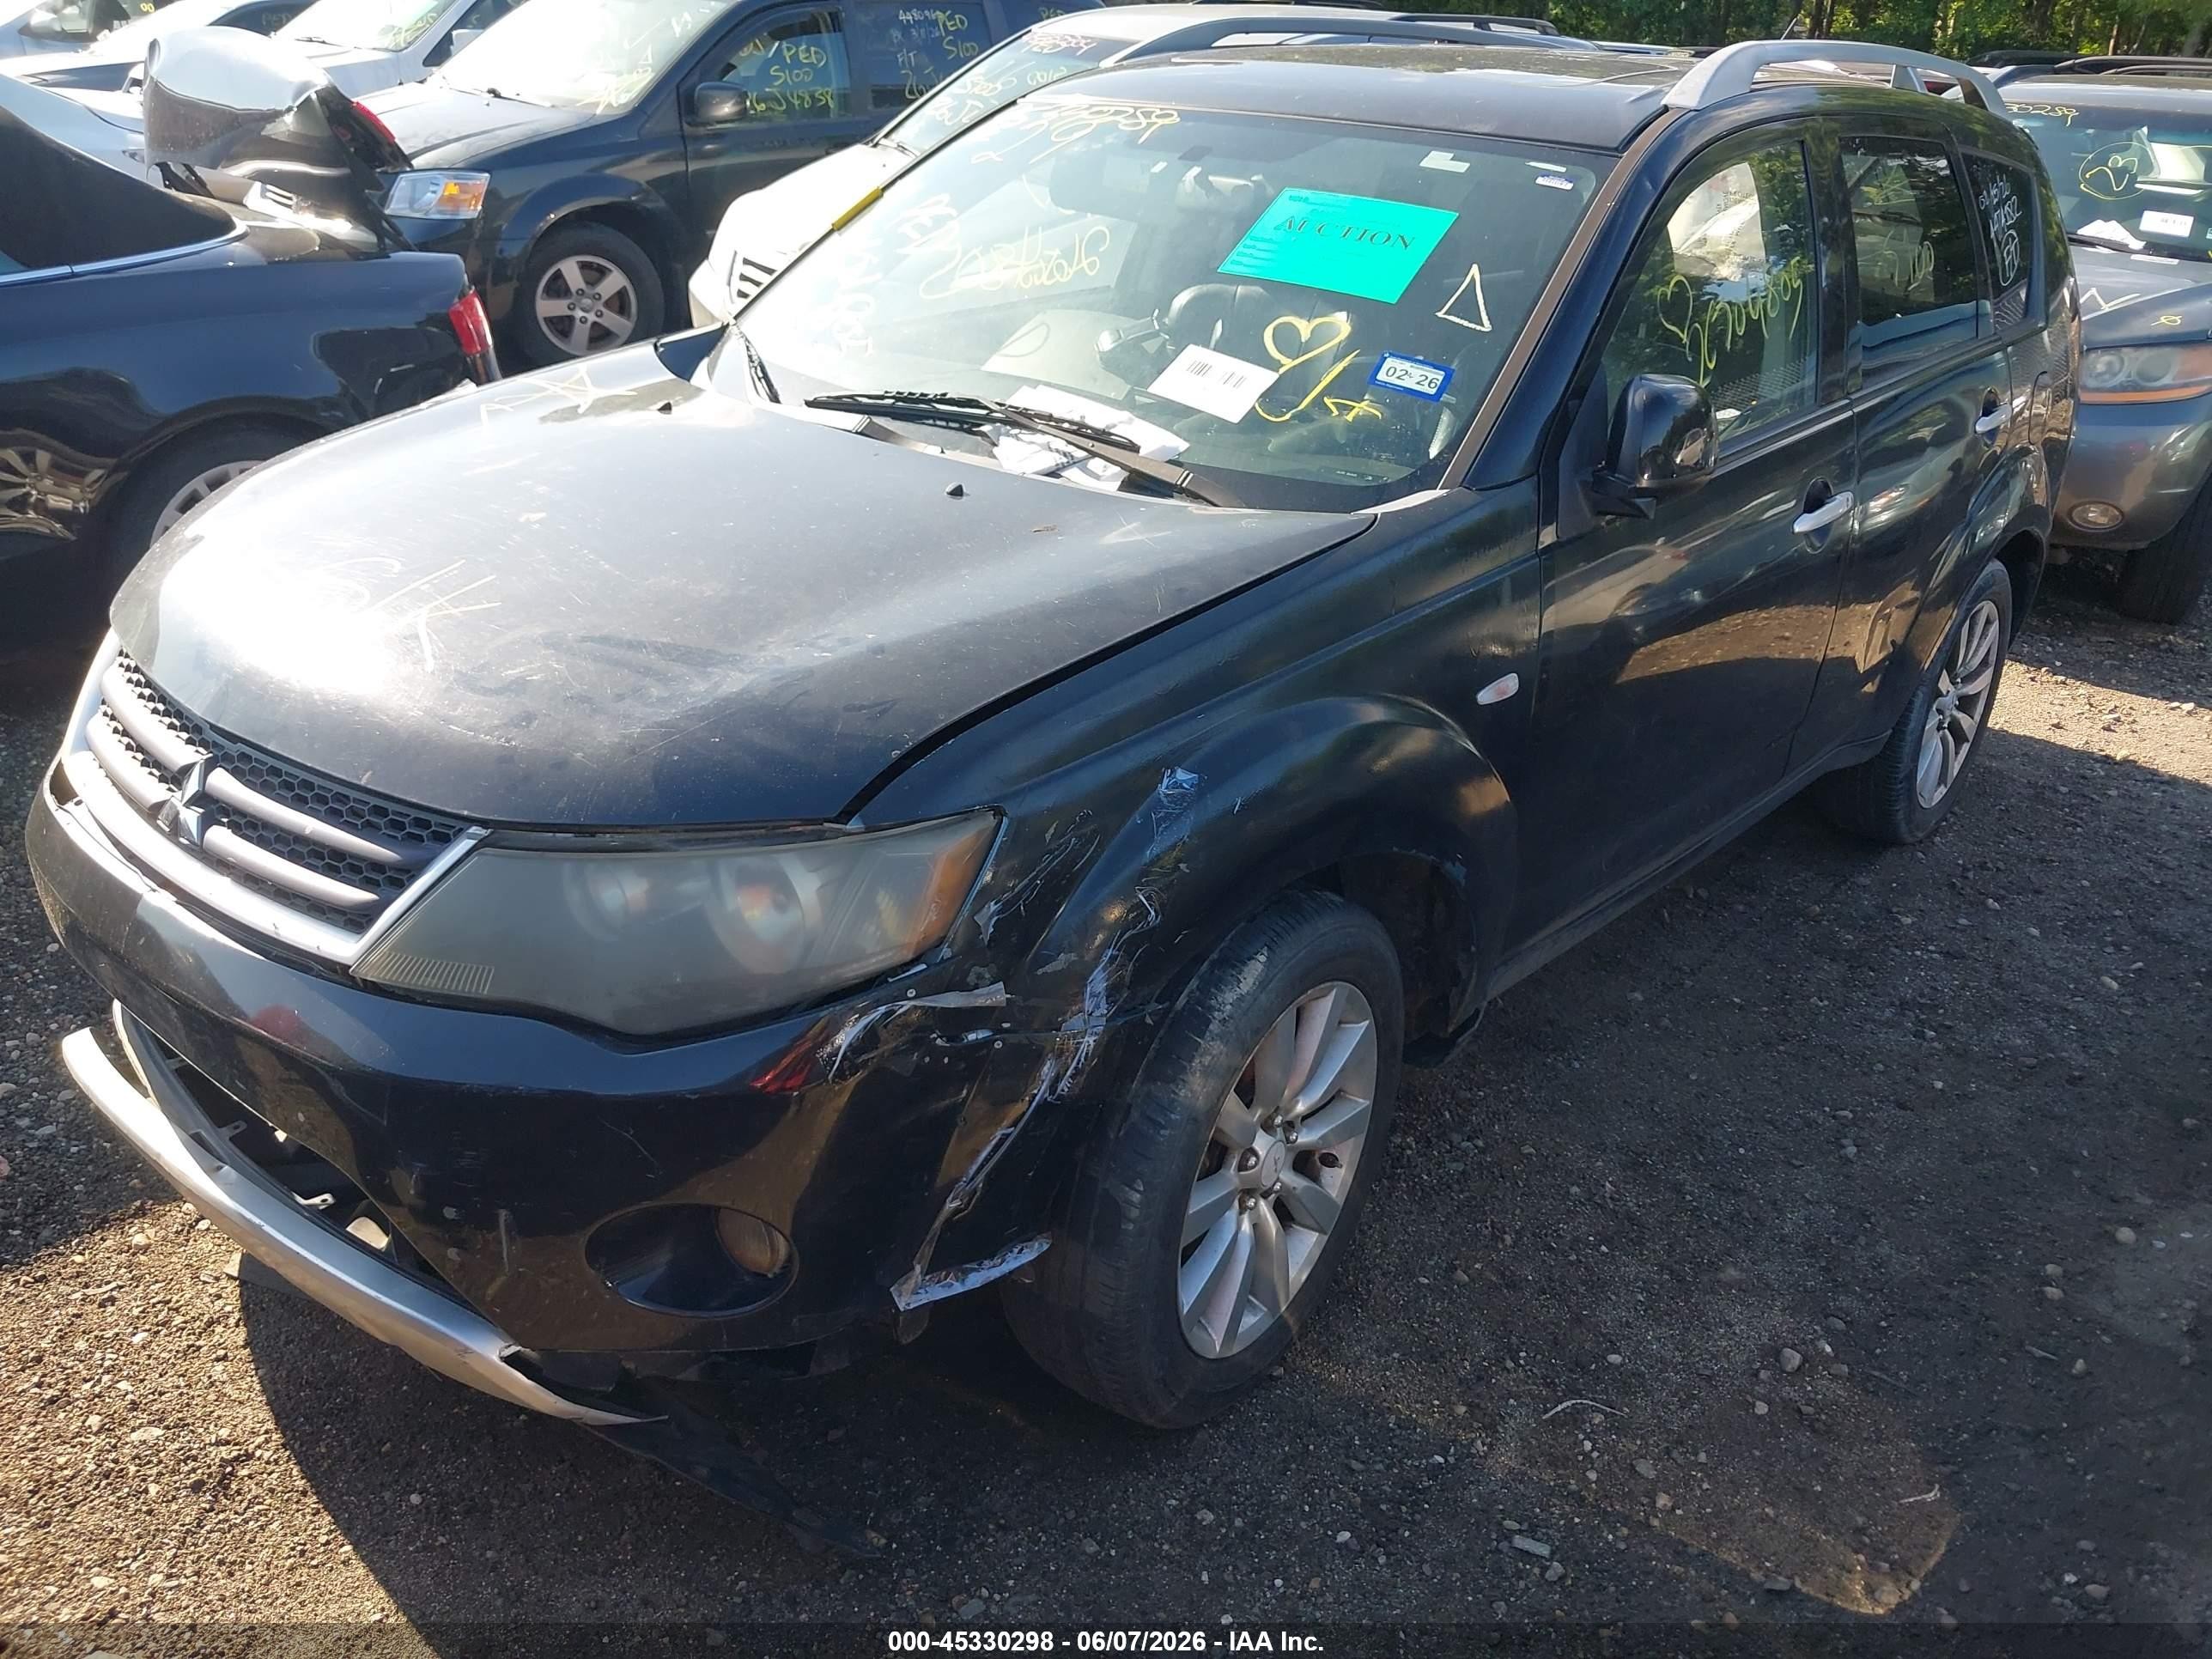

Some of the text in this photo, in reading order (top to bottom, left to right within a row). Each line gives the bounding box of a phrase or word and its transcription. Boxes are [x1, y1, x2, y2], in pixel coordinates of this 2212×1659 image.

[782, 42, 827, 68] PED
[769, 65, 813, 86] S100
[1385, 366, 1408, 380] 02
[1414, 374, 1440, 389] 26
